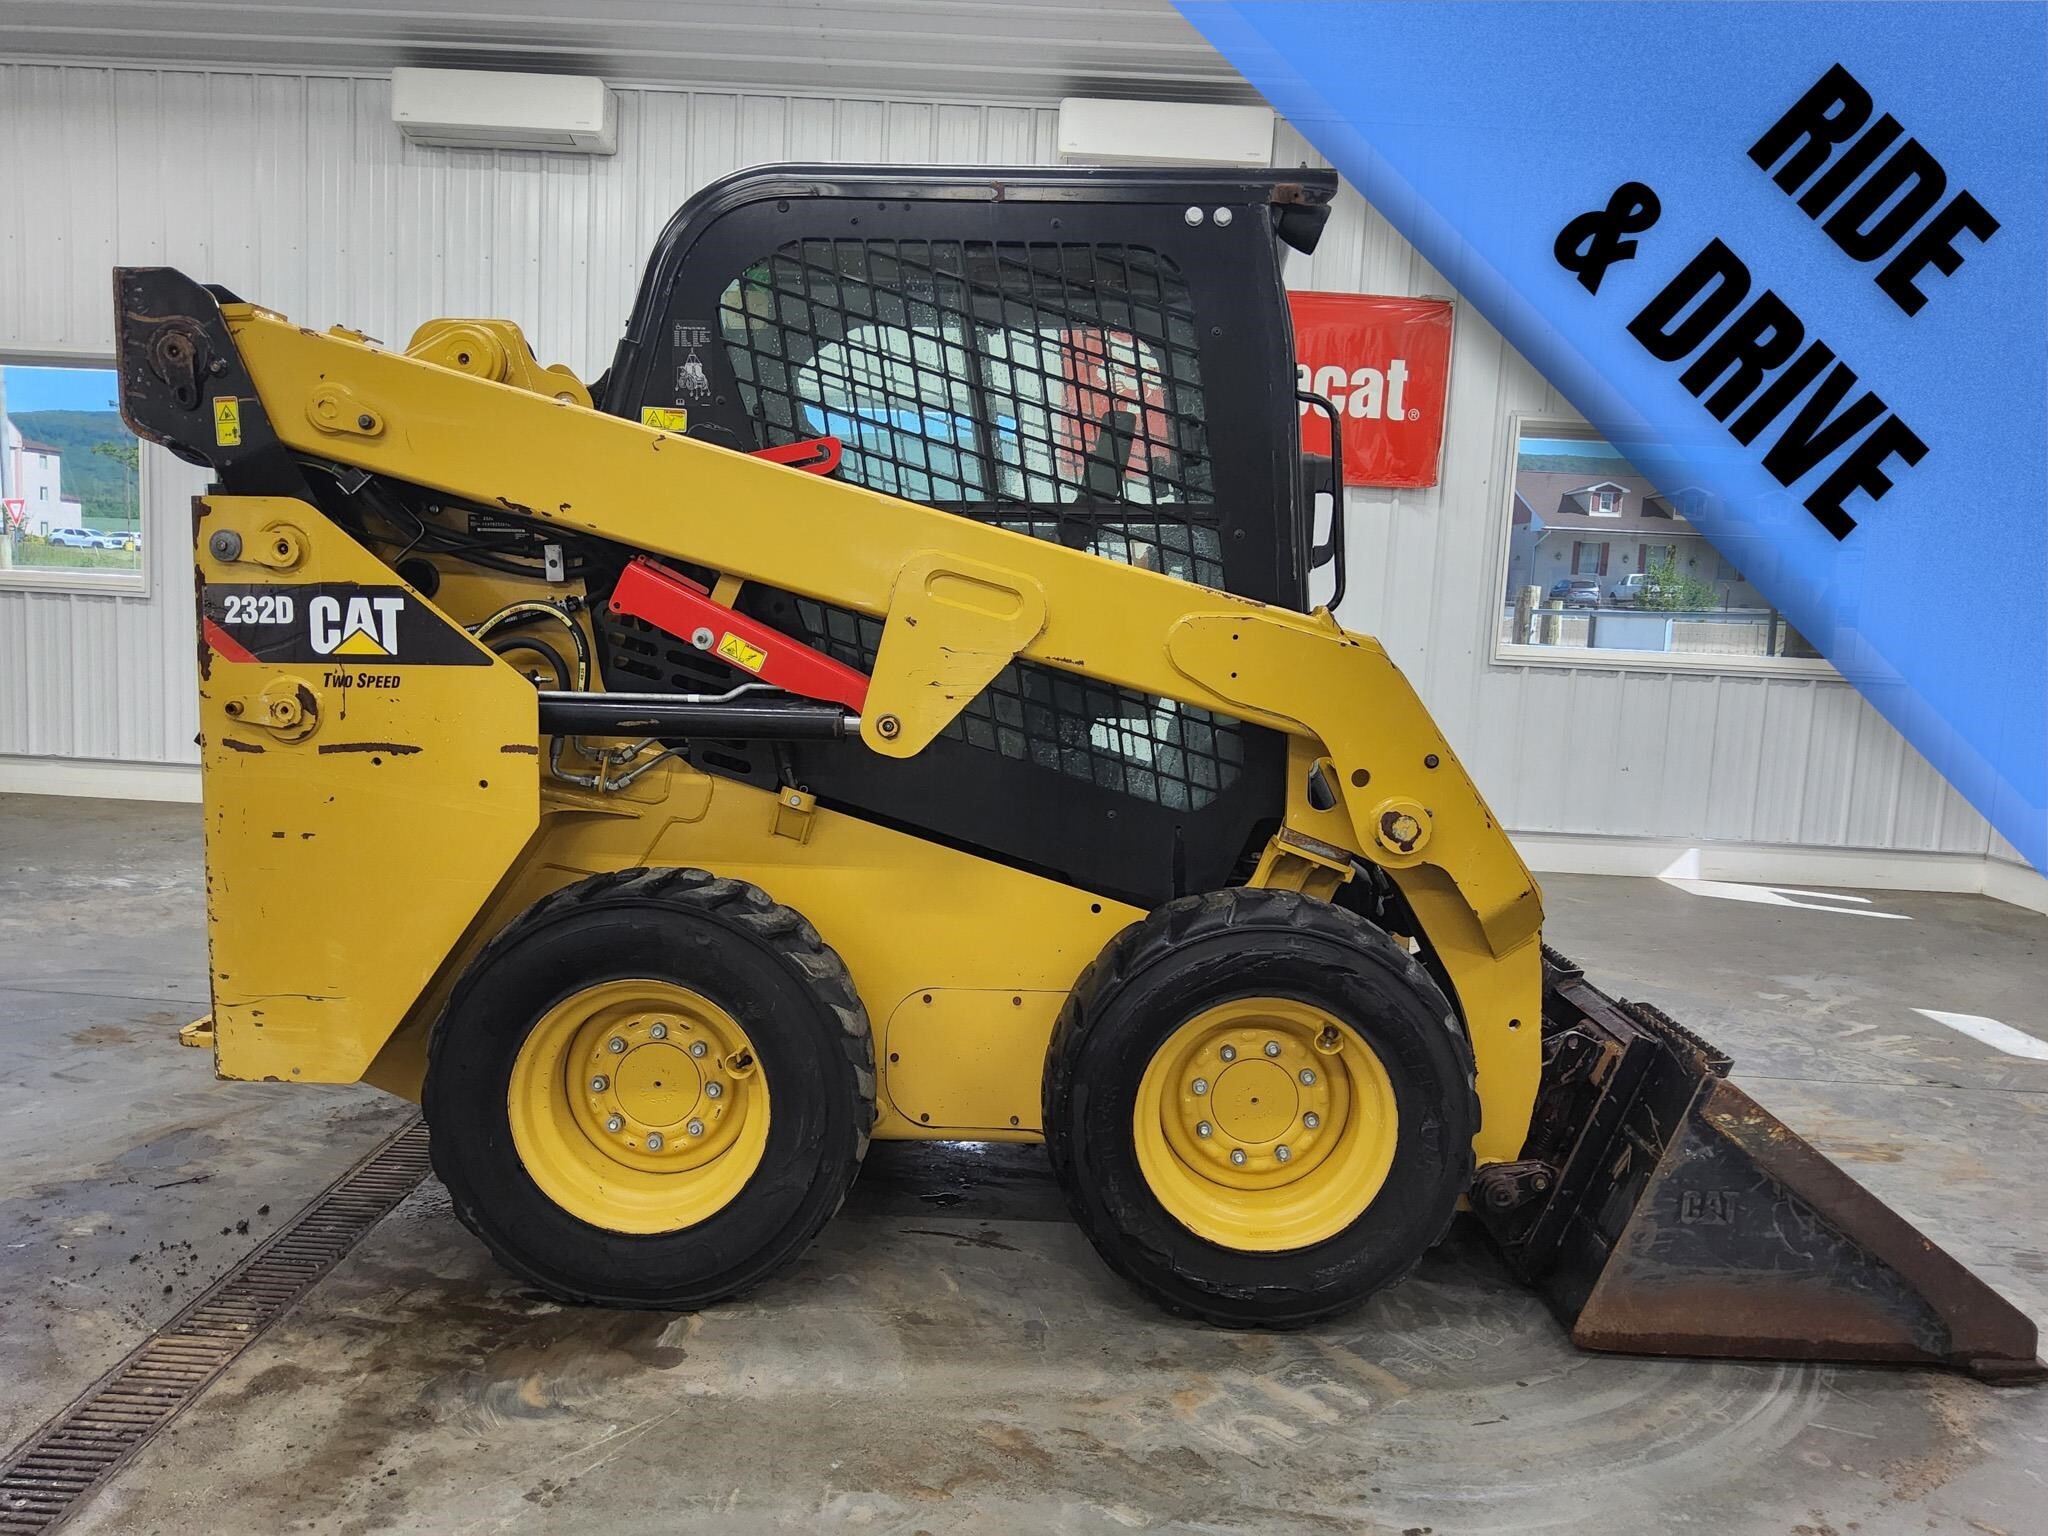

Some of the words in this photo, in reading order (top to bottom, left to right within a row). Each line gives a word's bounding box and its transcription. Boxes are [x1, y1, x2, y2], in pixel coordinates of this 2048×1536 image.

[224, 595, 294, 624] 232D
[309, 595, 405, 656] CAT
[1680, 1190, 1740, 1225] CAT
